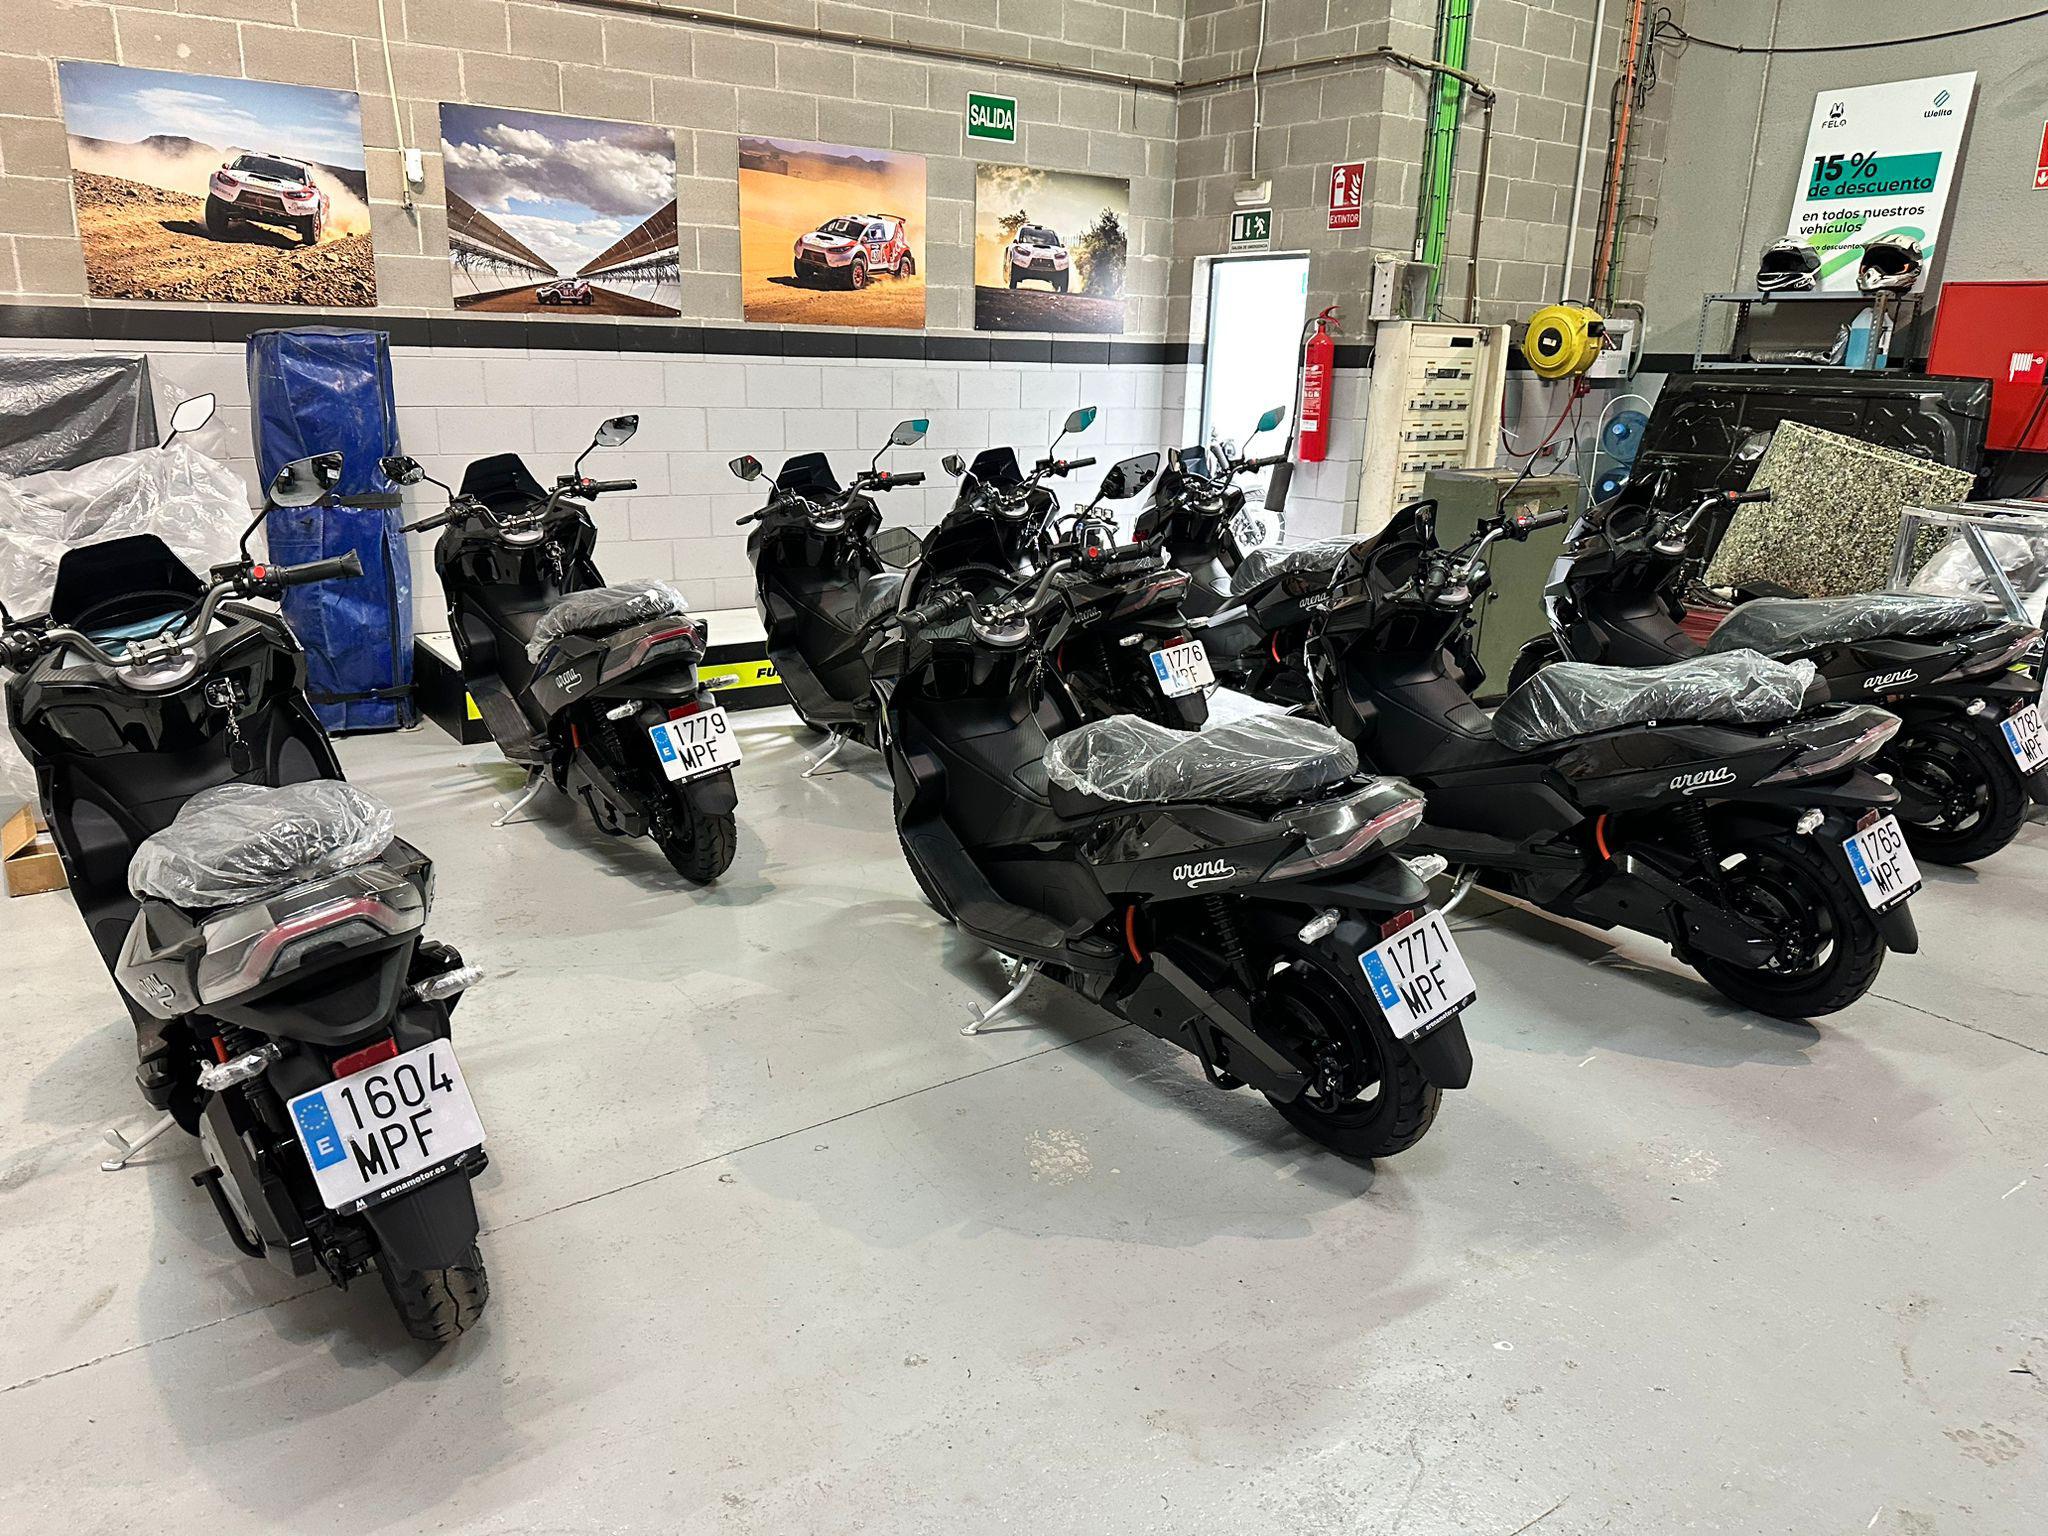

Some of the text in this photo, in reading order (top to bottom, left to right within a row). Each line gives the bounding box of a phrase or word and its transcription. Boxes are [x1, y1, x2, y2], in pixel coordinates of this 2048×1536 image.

[971, 104, 1013, 130] SALIDA
[1821, 119, 1847, 128] FELO
[1814, 150, 1878, 182] 15 %
[1808, 177, 1932, 197] de descuento
[1330, 213, 1359, 224] EXTINTOR
[1799, 222, 1862, 235] vehículos
[1802, 206, 1925, 222] en todos nuestros
[1166, 644, 1203, 669] 1776
[756, 667, 780, 679] FU
[1863, 667, 1919, 692] arena
[673, 712, 726, 746] 1779
[2012, 709, 2042, 739] 1782
[662, 746, 672, 756] E
[678, 739, 718, 771] MPF
[2020, 734, 2044, 763] MPF
[1669, 765, 1737, 796] arena
[1861, 821, 1901, 864] 1765
[1172, 857, 1236, 889] arena
[1870, 854, 1903, 896] MPF
[1387, 920, 1449, 980] 1771
[1381, 984, 1392, 998] E
[1397, 963, 1448, 1020] MPF
[340, 1051, 454, 1131] 1604
[316, 1135, 334, 1155] E
[349, 1107, 434, 1183] MPF
[380, 1164, 447, 1199] arenamotor.es
